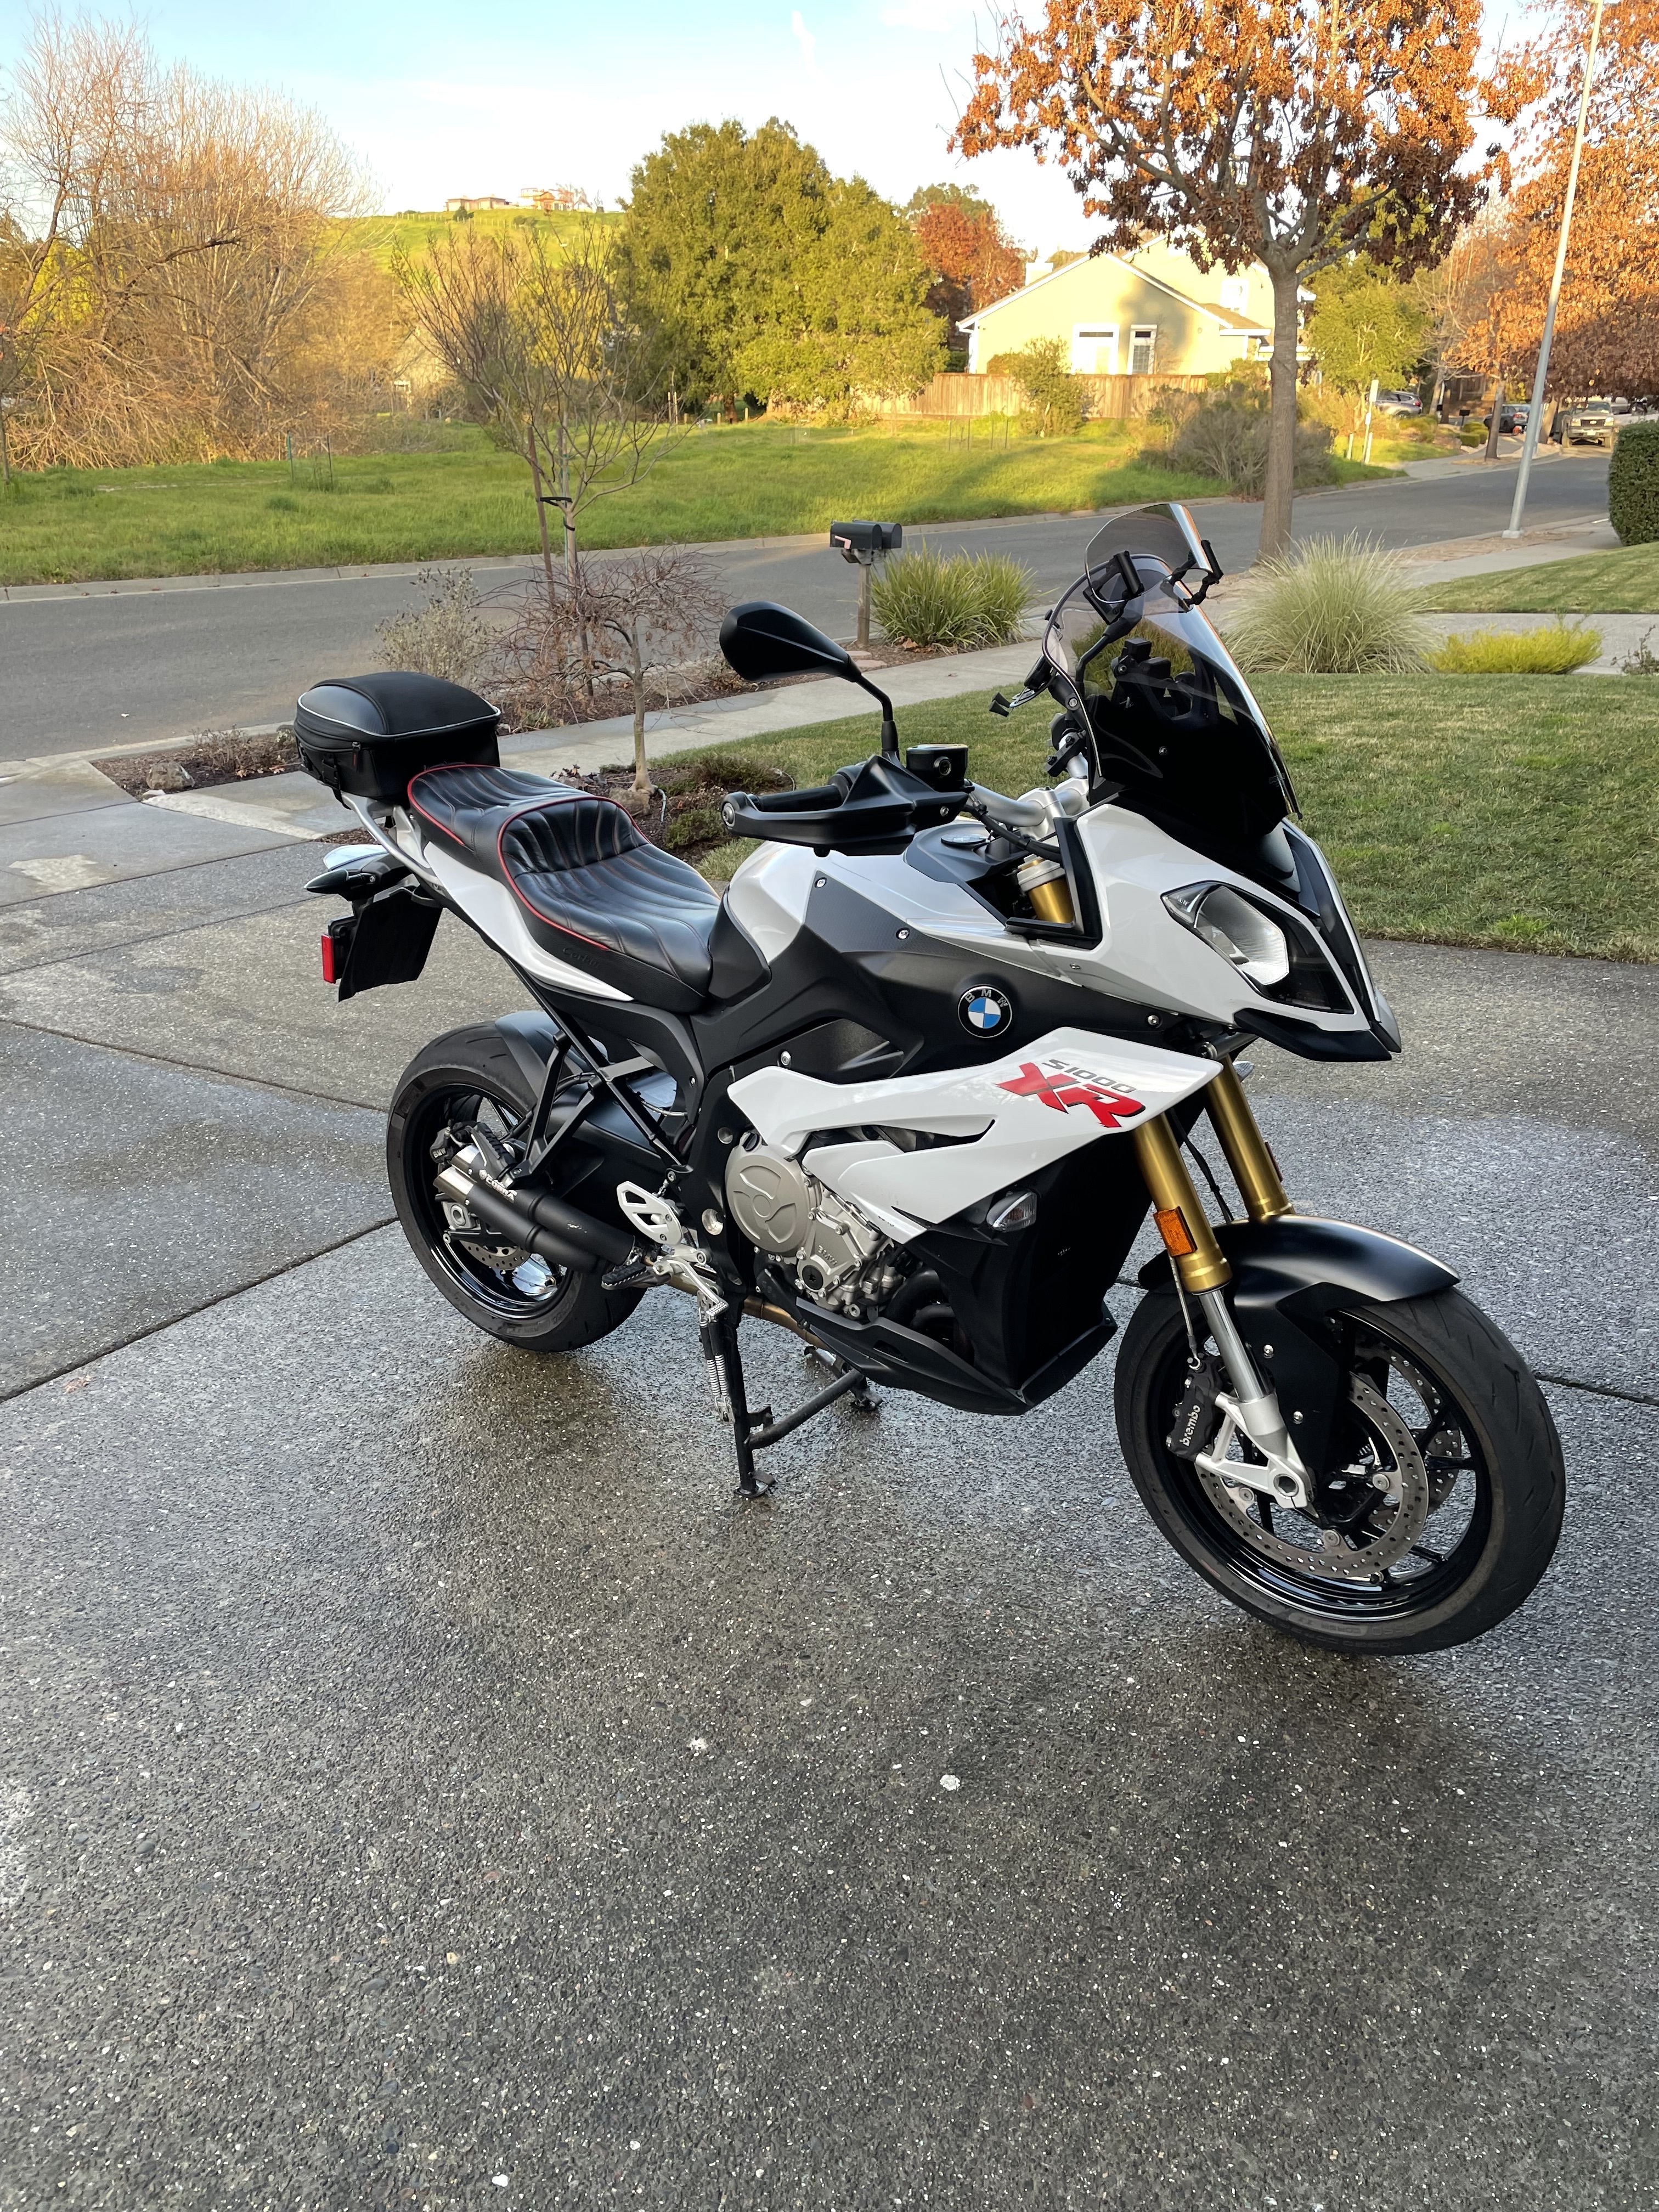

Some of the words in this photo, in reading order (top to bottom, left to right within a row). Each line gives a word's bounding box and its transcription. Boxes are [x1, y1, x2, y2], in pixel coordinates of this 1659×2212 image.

[964, 989, 1008, 1008] BMW
[1042, 1059, 1137, 1093] S1000
[994, 1062, 1146, 1128] XR
[432, 1147, 446, 1158] BMW
[486, 1176, 515, 1201] COBRA
[1179, 1404, 1201, 1447] brembo
